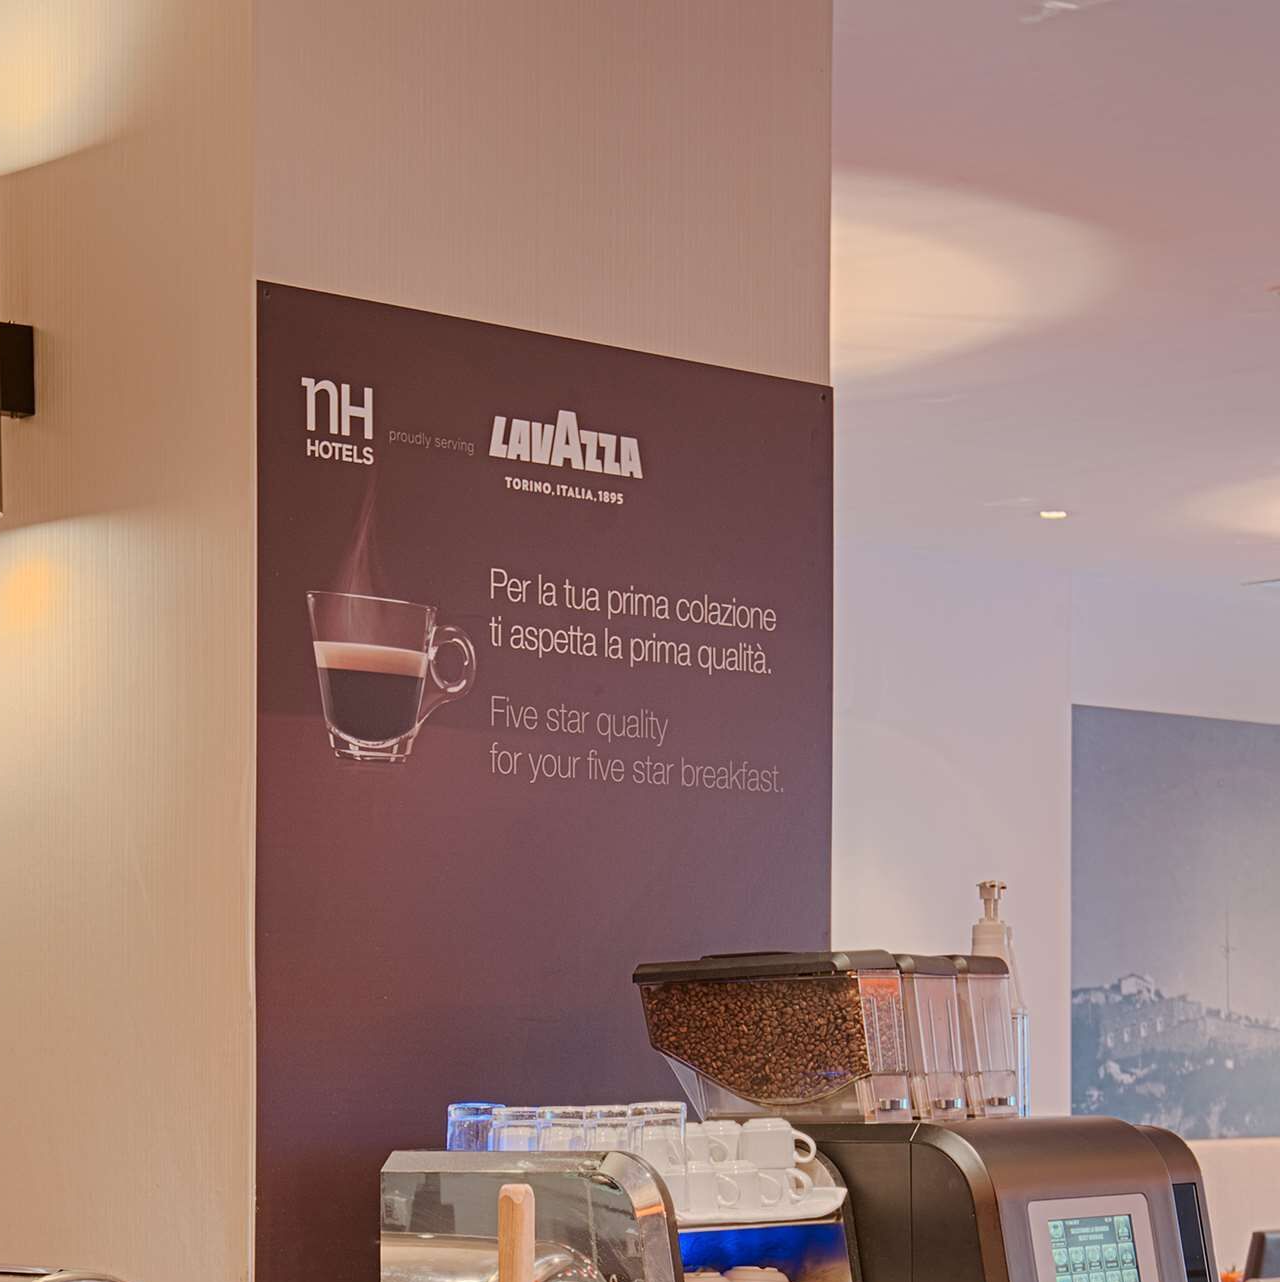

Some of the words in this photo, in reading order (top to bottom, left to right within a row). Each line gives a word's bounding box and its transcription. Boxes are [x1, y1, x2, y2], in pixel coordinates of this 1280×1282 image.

[306, 437, 375, 466] HOTELS
[388, 430, 433, 447] proudly
[434, 437, 475, 456] serving
[488, 409, 644, 480] LAVAZZA
[597, 490, 625, 505] 1895
[490, 567, 532, 605] Per
[537, 574, 558, 607] la
[562, 578, 601, 612] tua
[607, 584, 671, 621] prima
[676, 593, 777, 632] colazione
[488, 615, 503, 647] ti
[509, 624, 598, 659] aspetta
[604, 627, 624, 660] la
[629, 632, 693, 668] prima
[697, 642, 772, 676] qualità.
[490, 695, 539, 731] Five
[545, 703, 591, 734] star
[596, 708, 669, 747] quality
[489, 741, 523, 775] for
[527, 752, 582, 784] your
[586, 748, 626, 783] five
[632, 755, 676, 786] star
[681, 756, 785, 794] breakfast.
